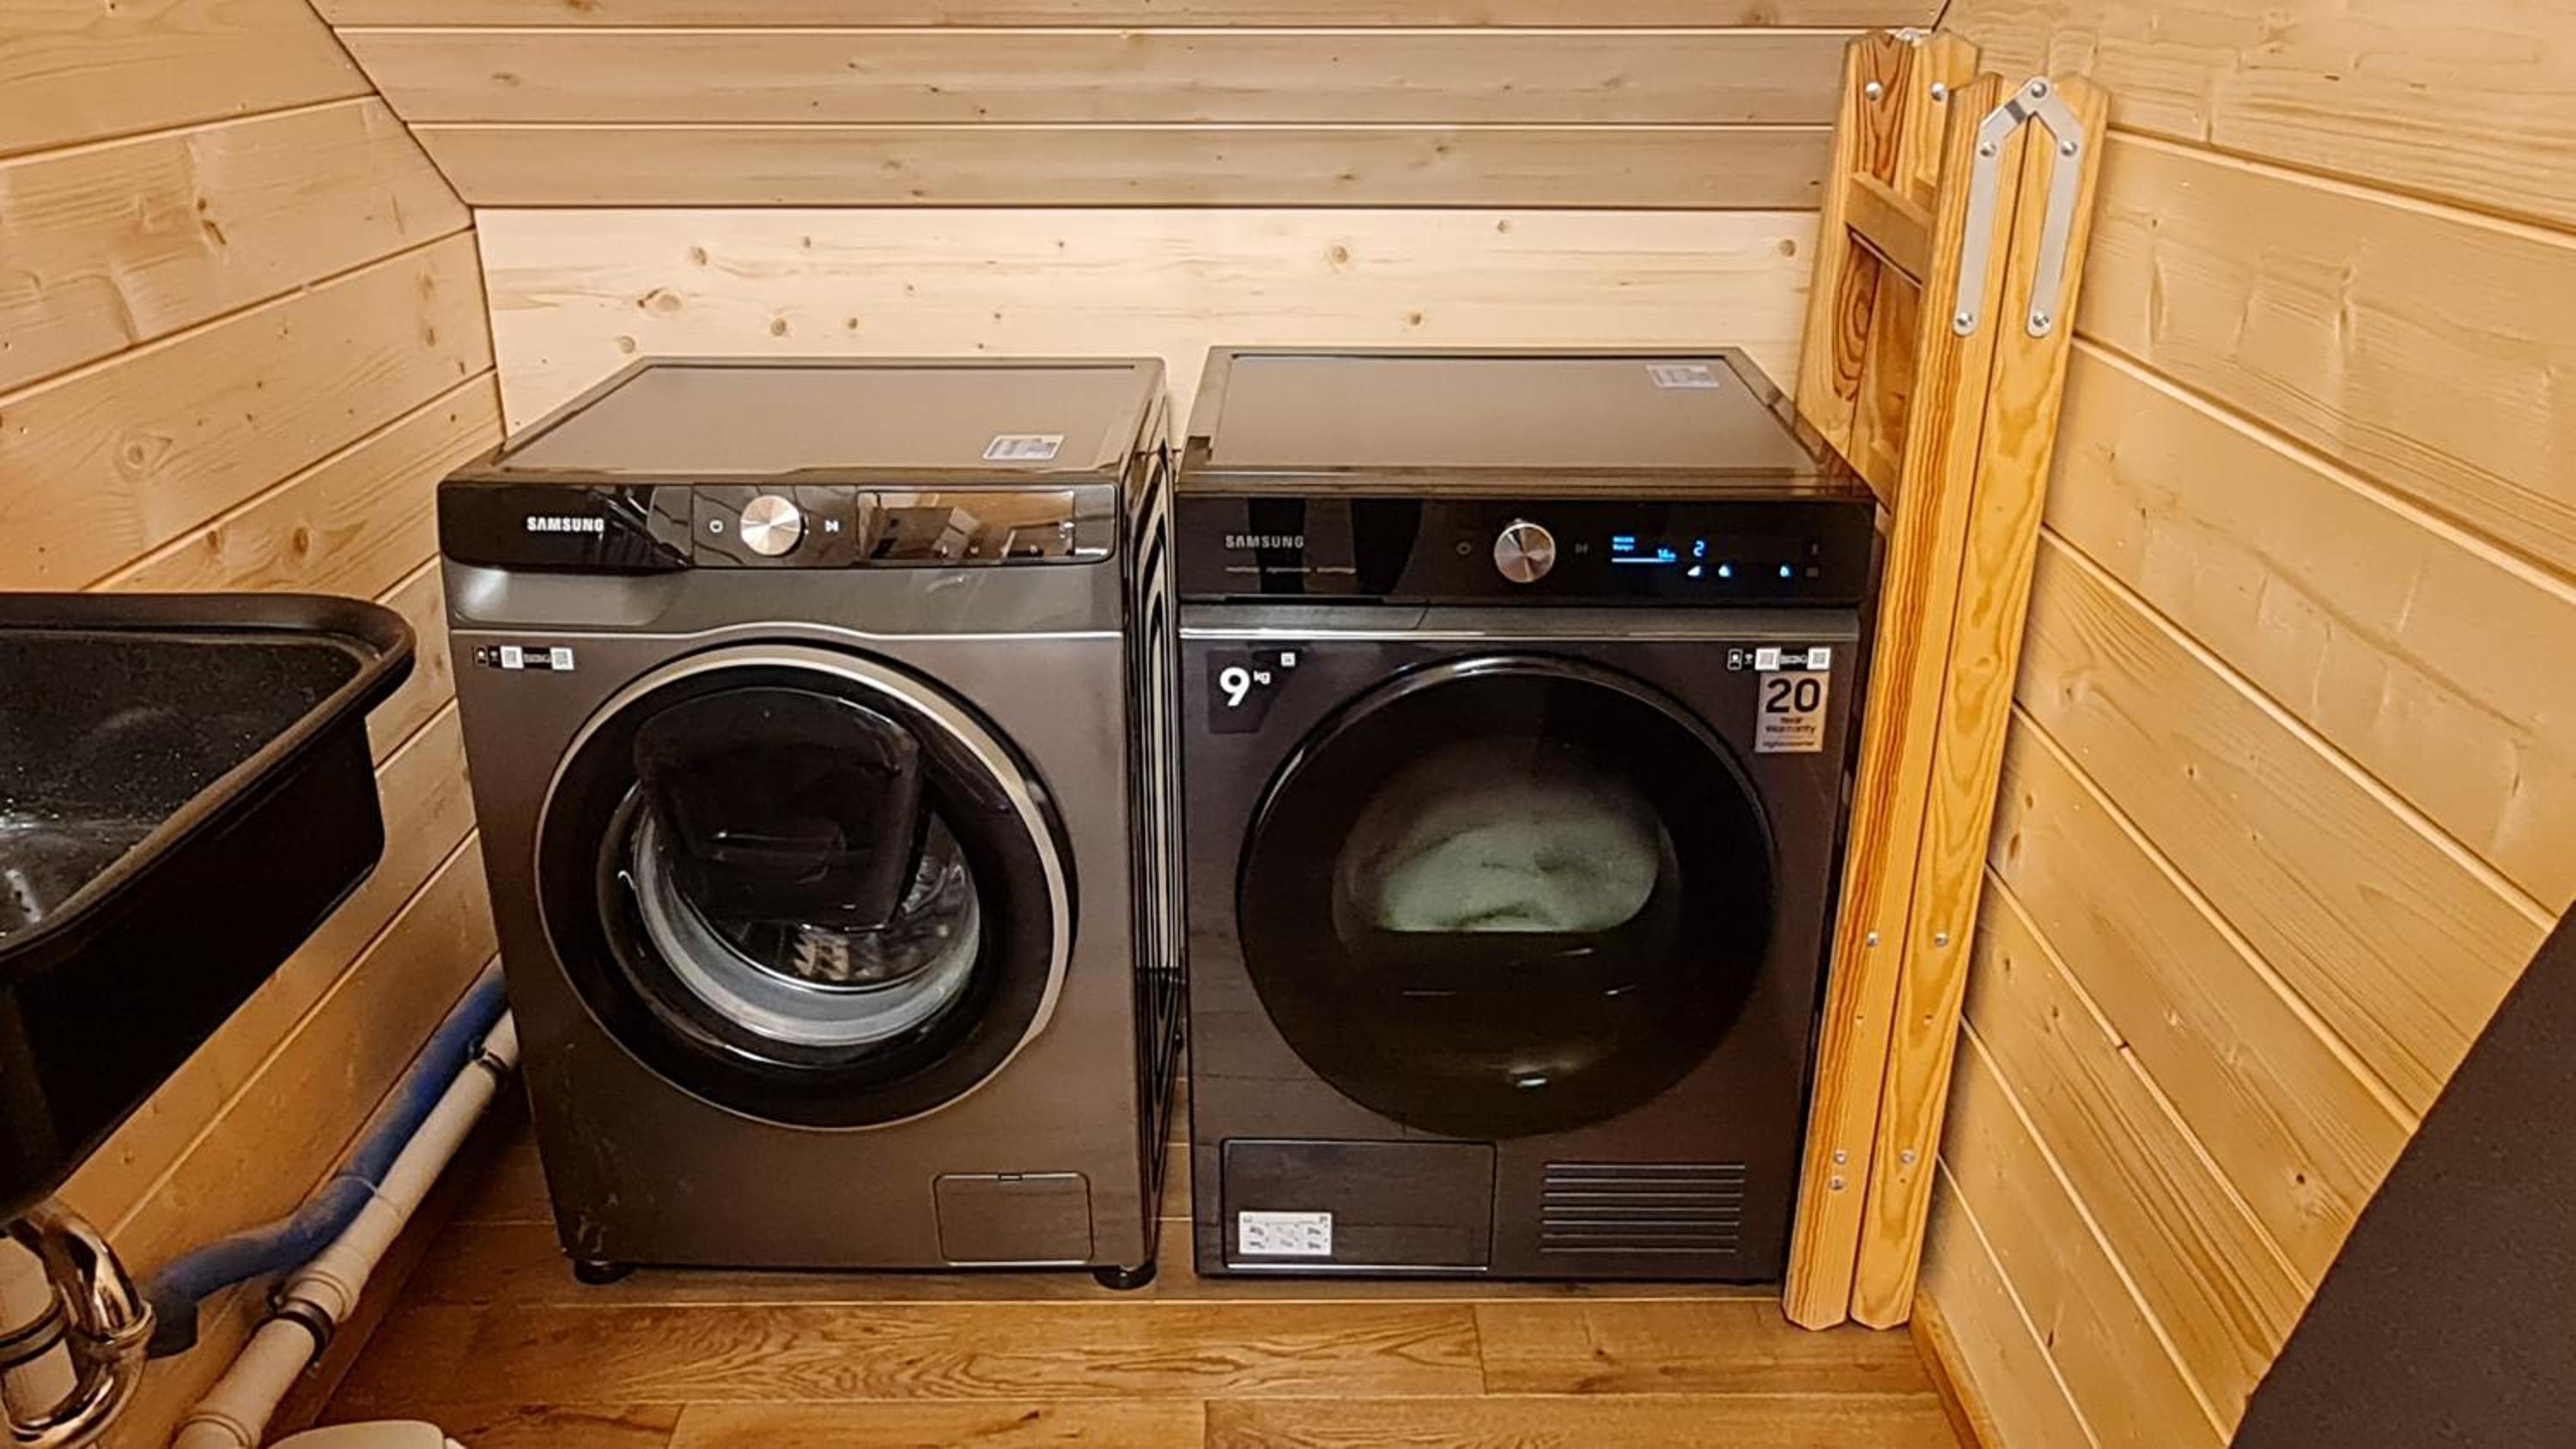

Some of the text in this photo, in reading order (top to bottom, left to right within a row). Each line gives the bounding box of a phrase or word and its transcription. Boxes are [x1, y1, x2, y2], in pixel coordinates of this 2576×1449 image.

[526, 516, 605, 532] SAMSUNG
[1224, 535, 1304, 549] SAMSUNG
[1220, 667, 1271, 706] 9 kg
[1765, 677, 1821, 713] 20
